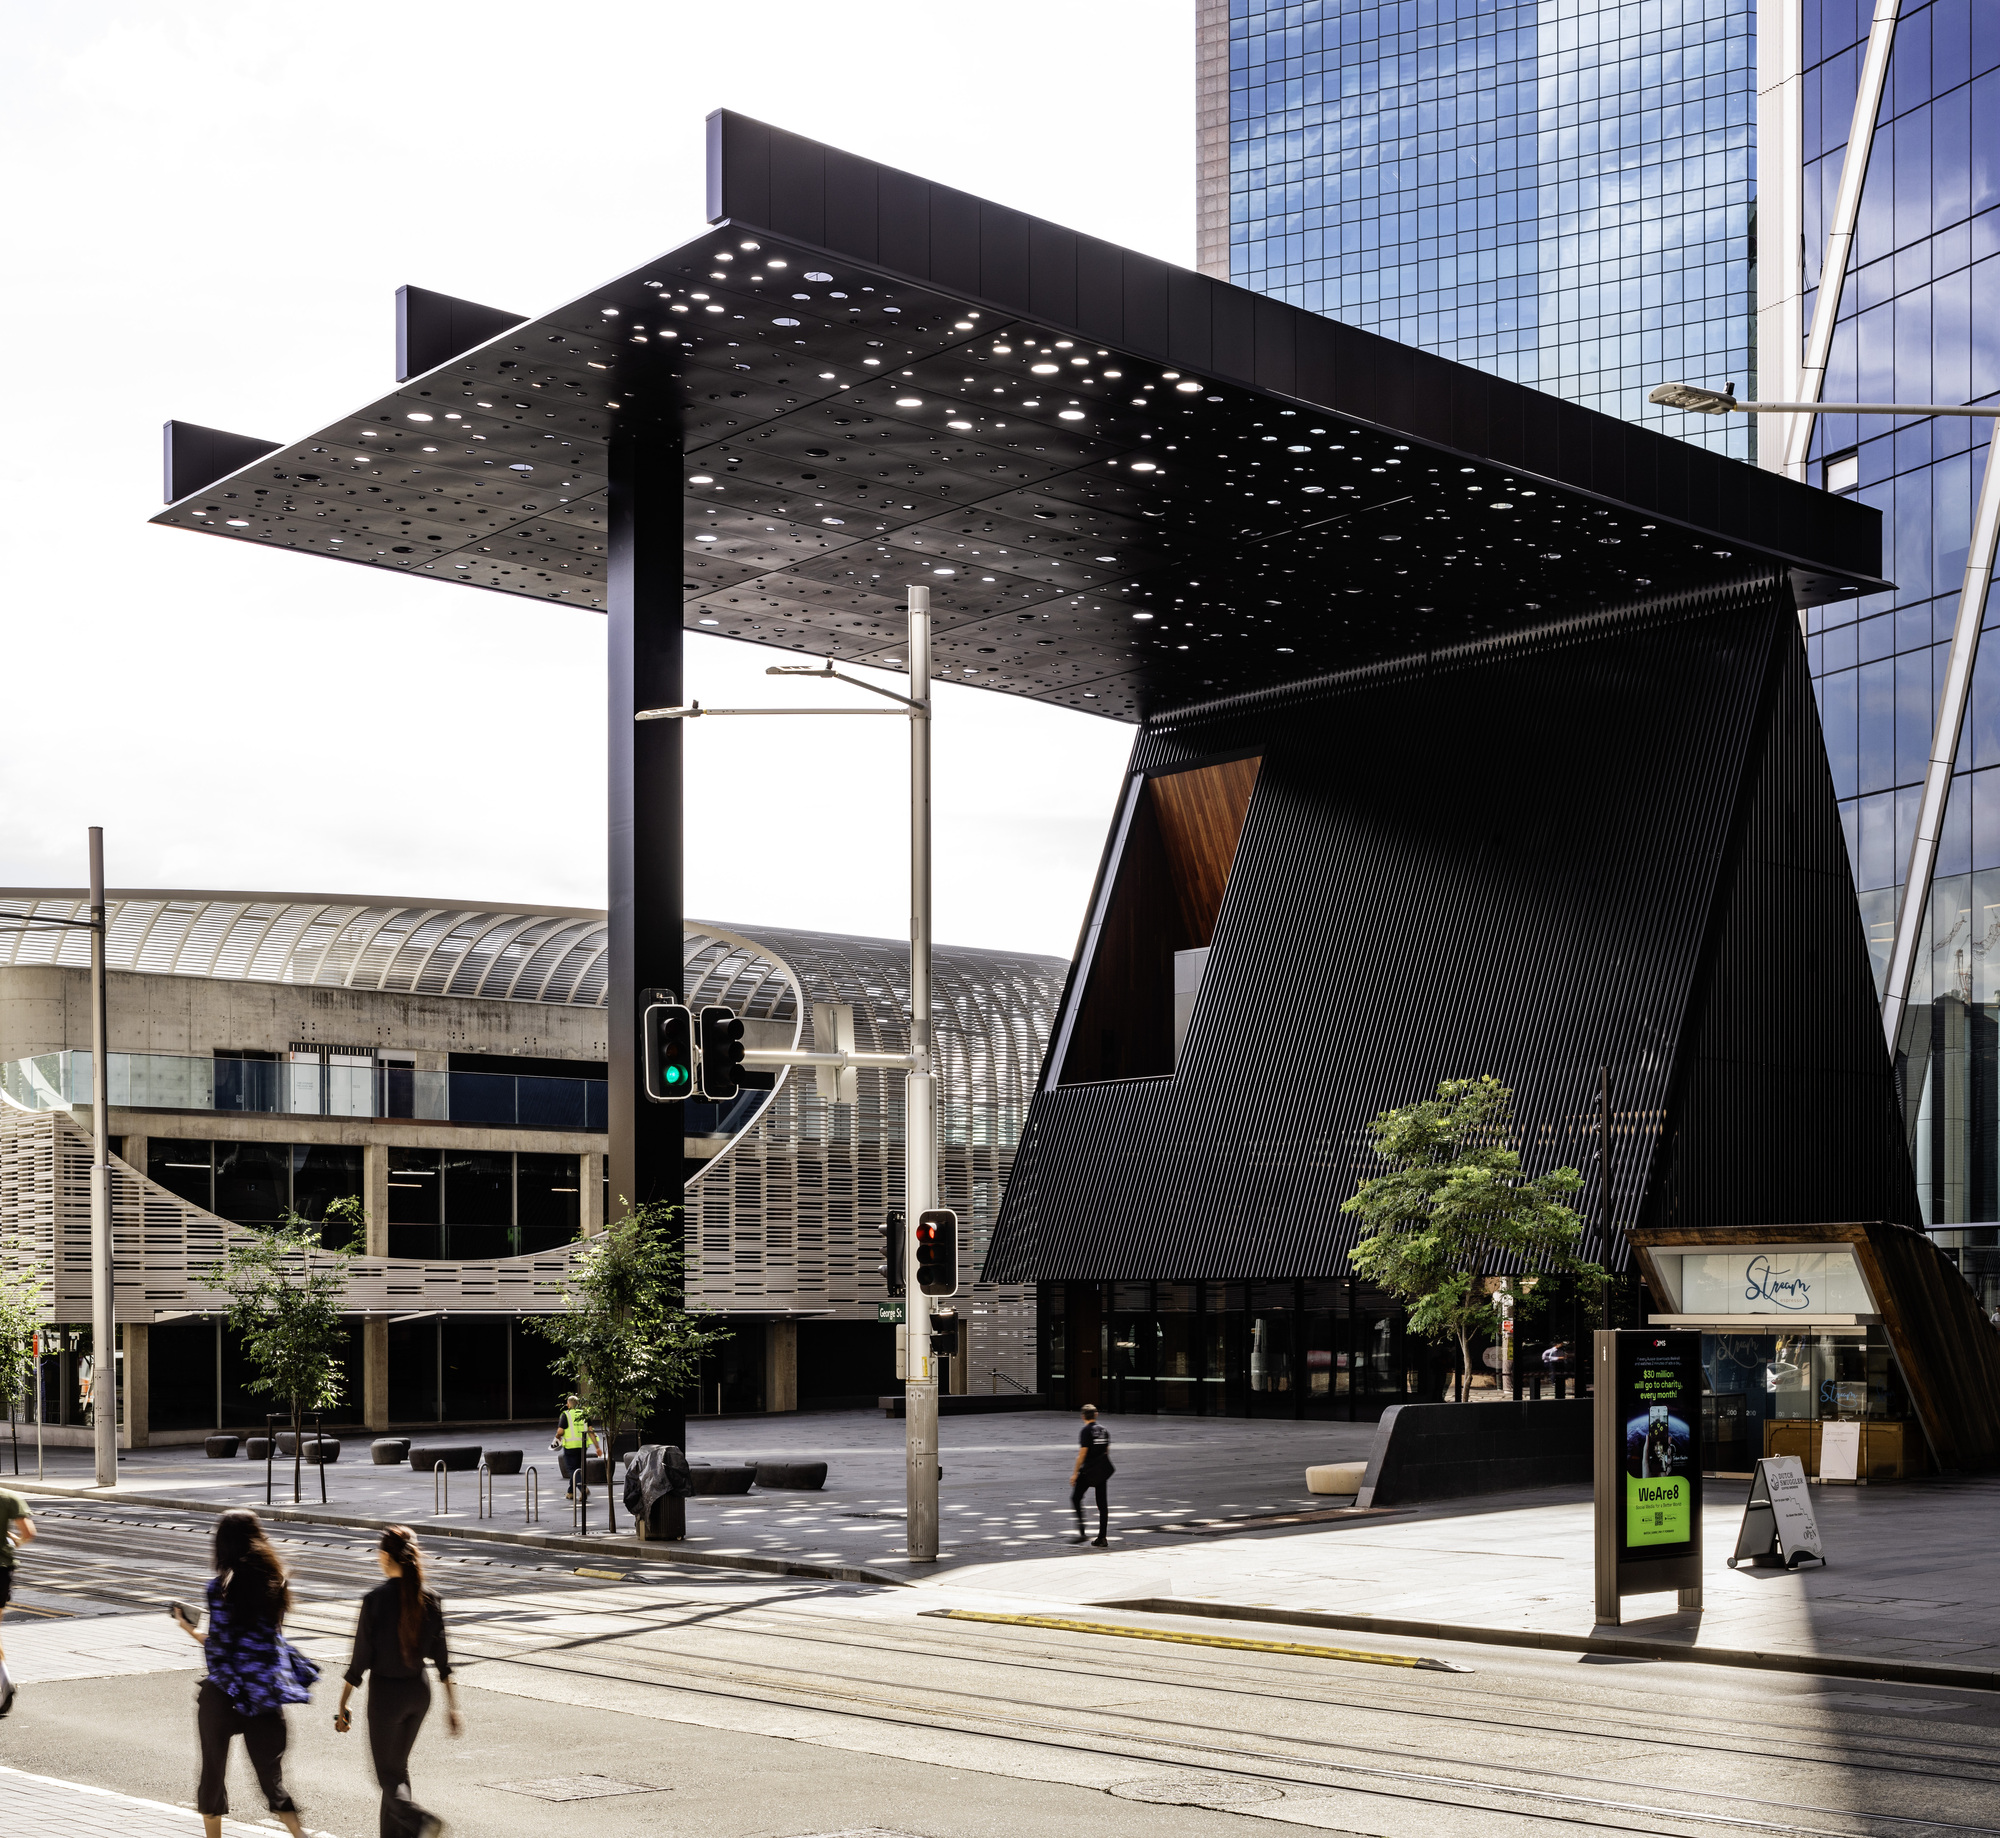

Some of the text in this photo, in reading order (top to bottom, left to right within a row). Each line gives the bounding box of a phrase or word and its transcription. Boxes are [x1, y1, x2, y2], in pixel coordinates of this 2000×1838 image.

[1745, 1255, 1811, 1310] Stream
[880, 1308, 903, 1320] George St
[1643, 1369, 1674, 1379] $30 million
[1634, 1381, 1644, 1389] will
[1661, 1380, 1683, 1389] charity,
[1640, 1390, 1677, 1400] every month!
[1820, 1379, 1858, 1408] Stream
[1780, 1478, 1803, 1486] SMUGGLER
[1638, 1484, 1679, 1502] WeAre8
[1804, 1529, 1816, 1540] OPEN
